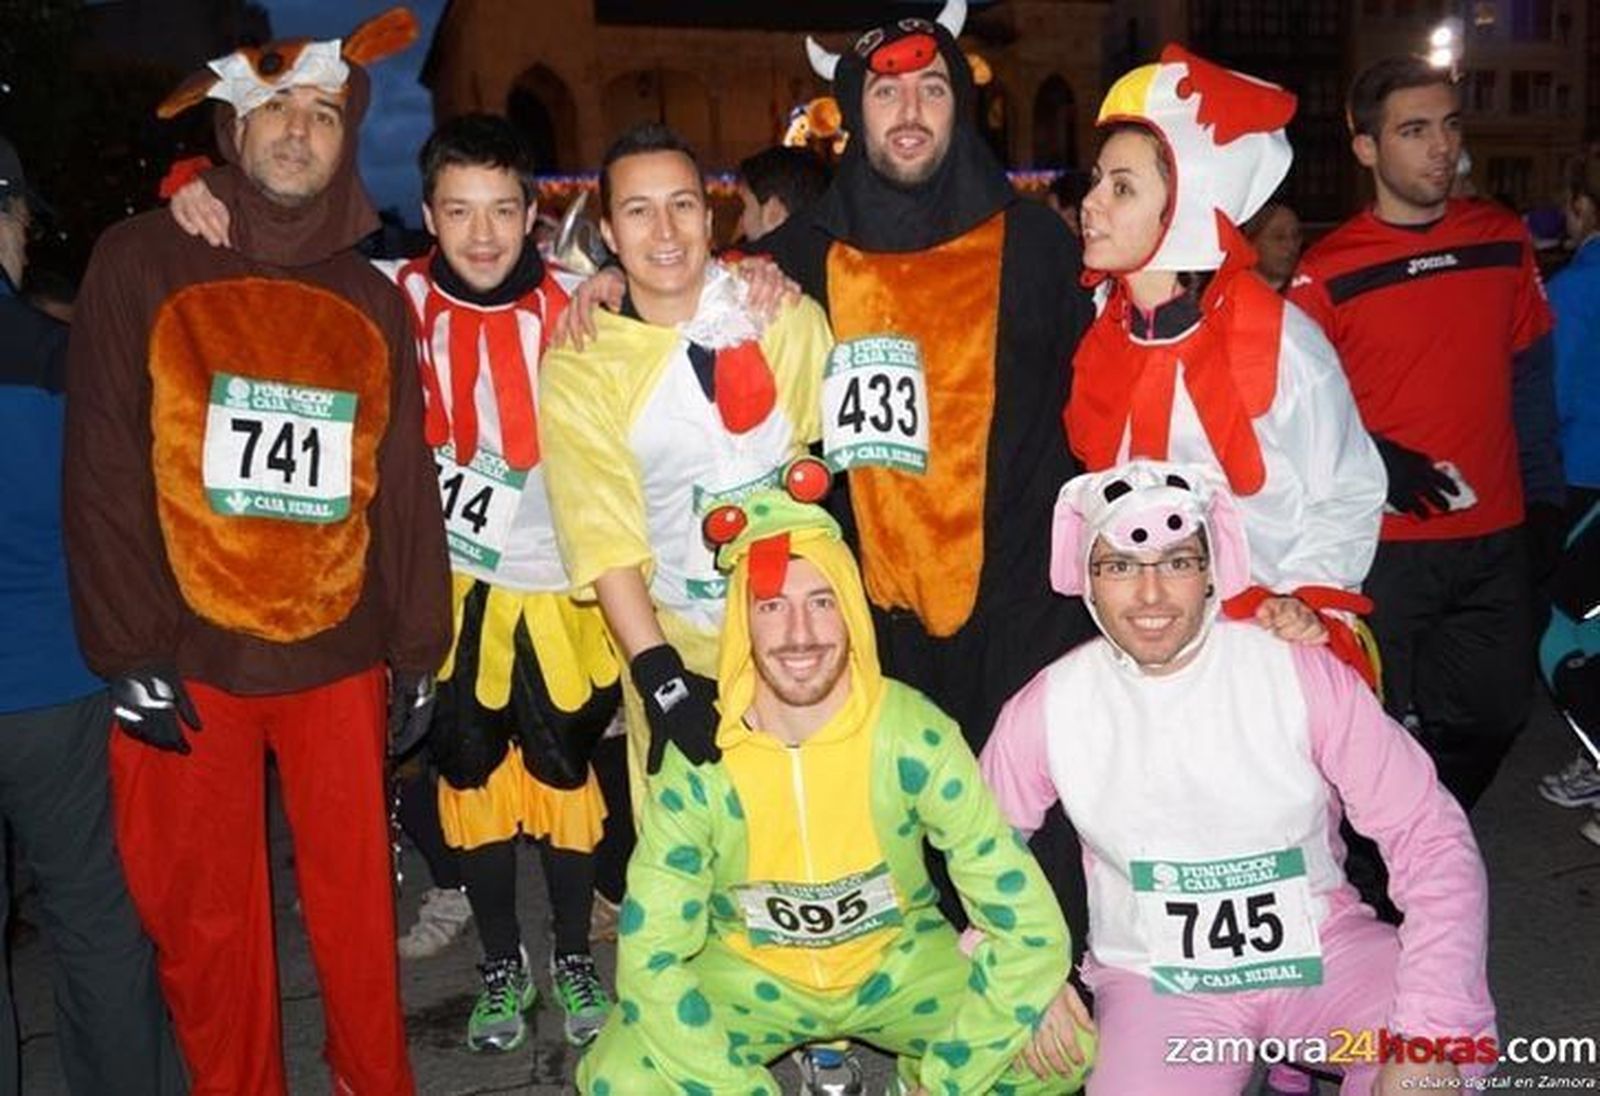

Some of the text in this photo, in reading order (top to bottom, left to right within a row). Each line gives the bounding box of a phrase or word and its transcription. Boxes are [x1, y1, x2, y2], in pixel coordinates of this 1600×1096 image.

[837, 373, 918, 437] 433
[231, 418, 320, 487] 741
[434, 461, 494, 535] 14
[1180, 855, 1277, 877] FUNDACION
[1225, 867, 1279, 887] RURAL
[765, 890, 868, 935] 695
[1165, 892, 1284, 959] 745
[1244, 964, 1303, 983] RURAL
